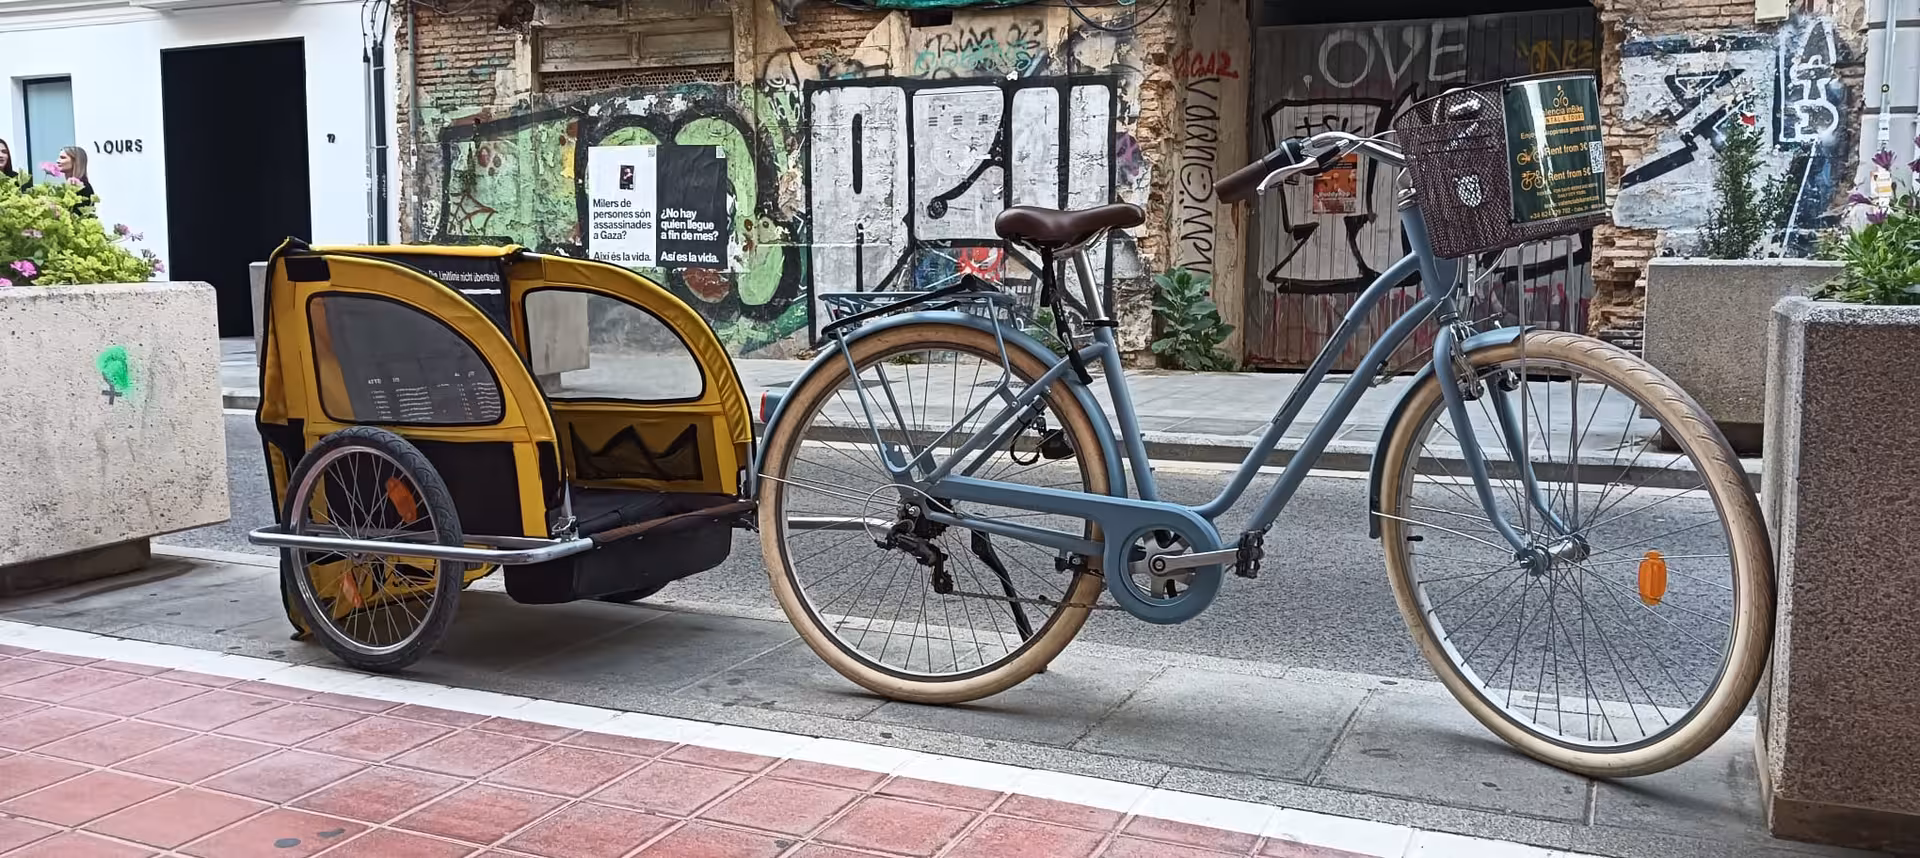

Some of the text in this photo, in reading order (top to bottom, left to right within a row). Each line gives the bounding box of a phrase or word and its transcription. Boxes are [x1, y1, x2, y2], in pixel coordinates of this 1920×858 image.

[1544, 142, 1589, 156] Rent from 3€
[1548, 166, 1592, 181] Rent from 5€
[593, 198, 632, 208] Milers de
[593, 208, 651, 220] persones són
[660, 207, 697, 220] ¿No hay
[593, 220, 652, 229] assassinades
[660, 219, 715, 231] quien llegue
[593, 230, 627, 240] a Gaza?
[660, 230, 719, 241] a fin de mes?
[622, 252, 630, 261] la
[631, 252, 652, 262] vida.
[660, 251, 719, 263] Así es la vida.
